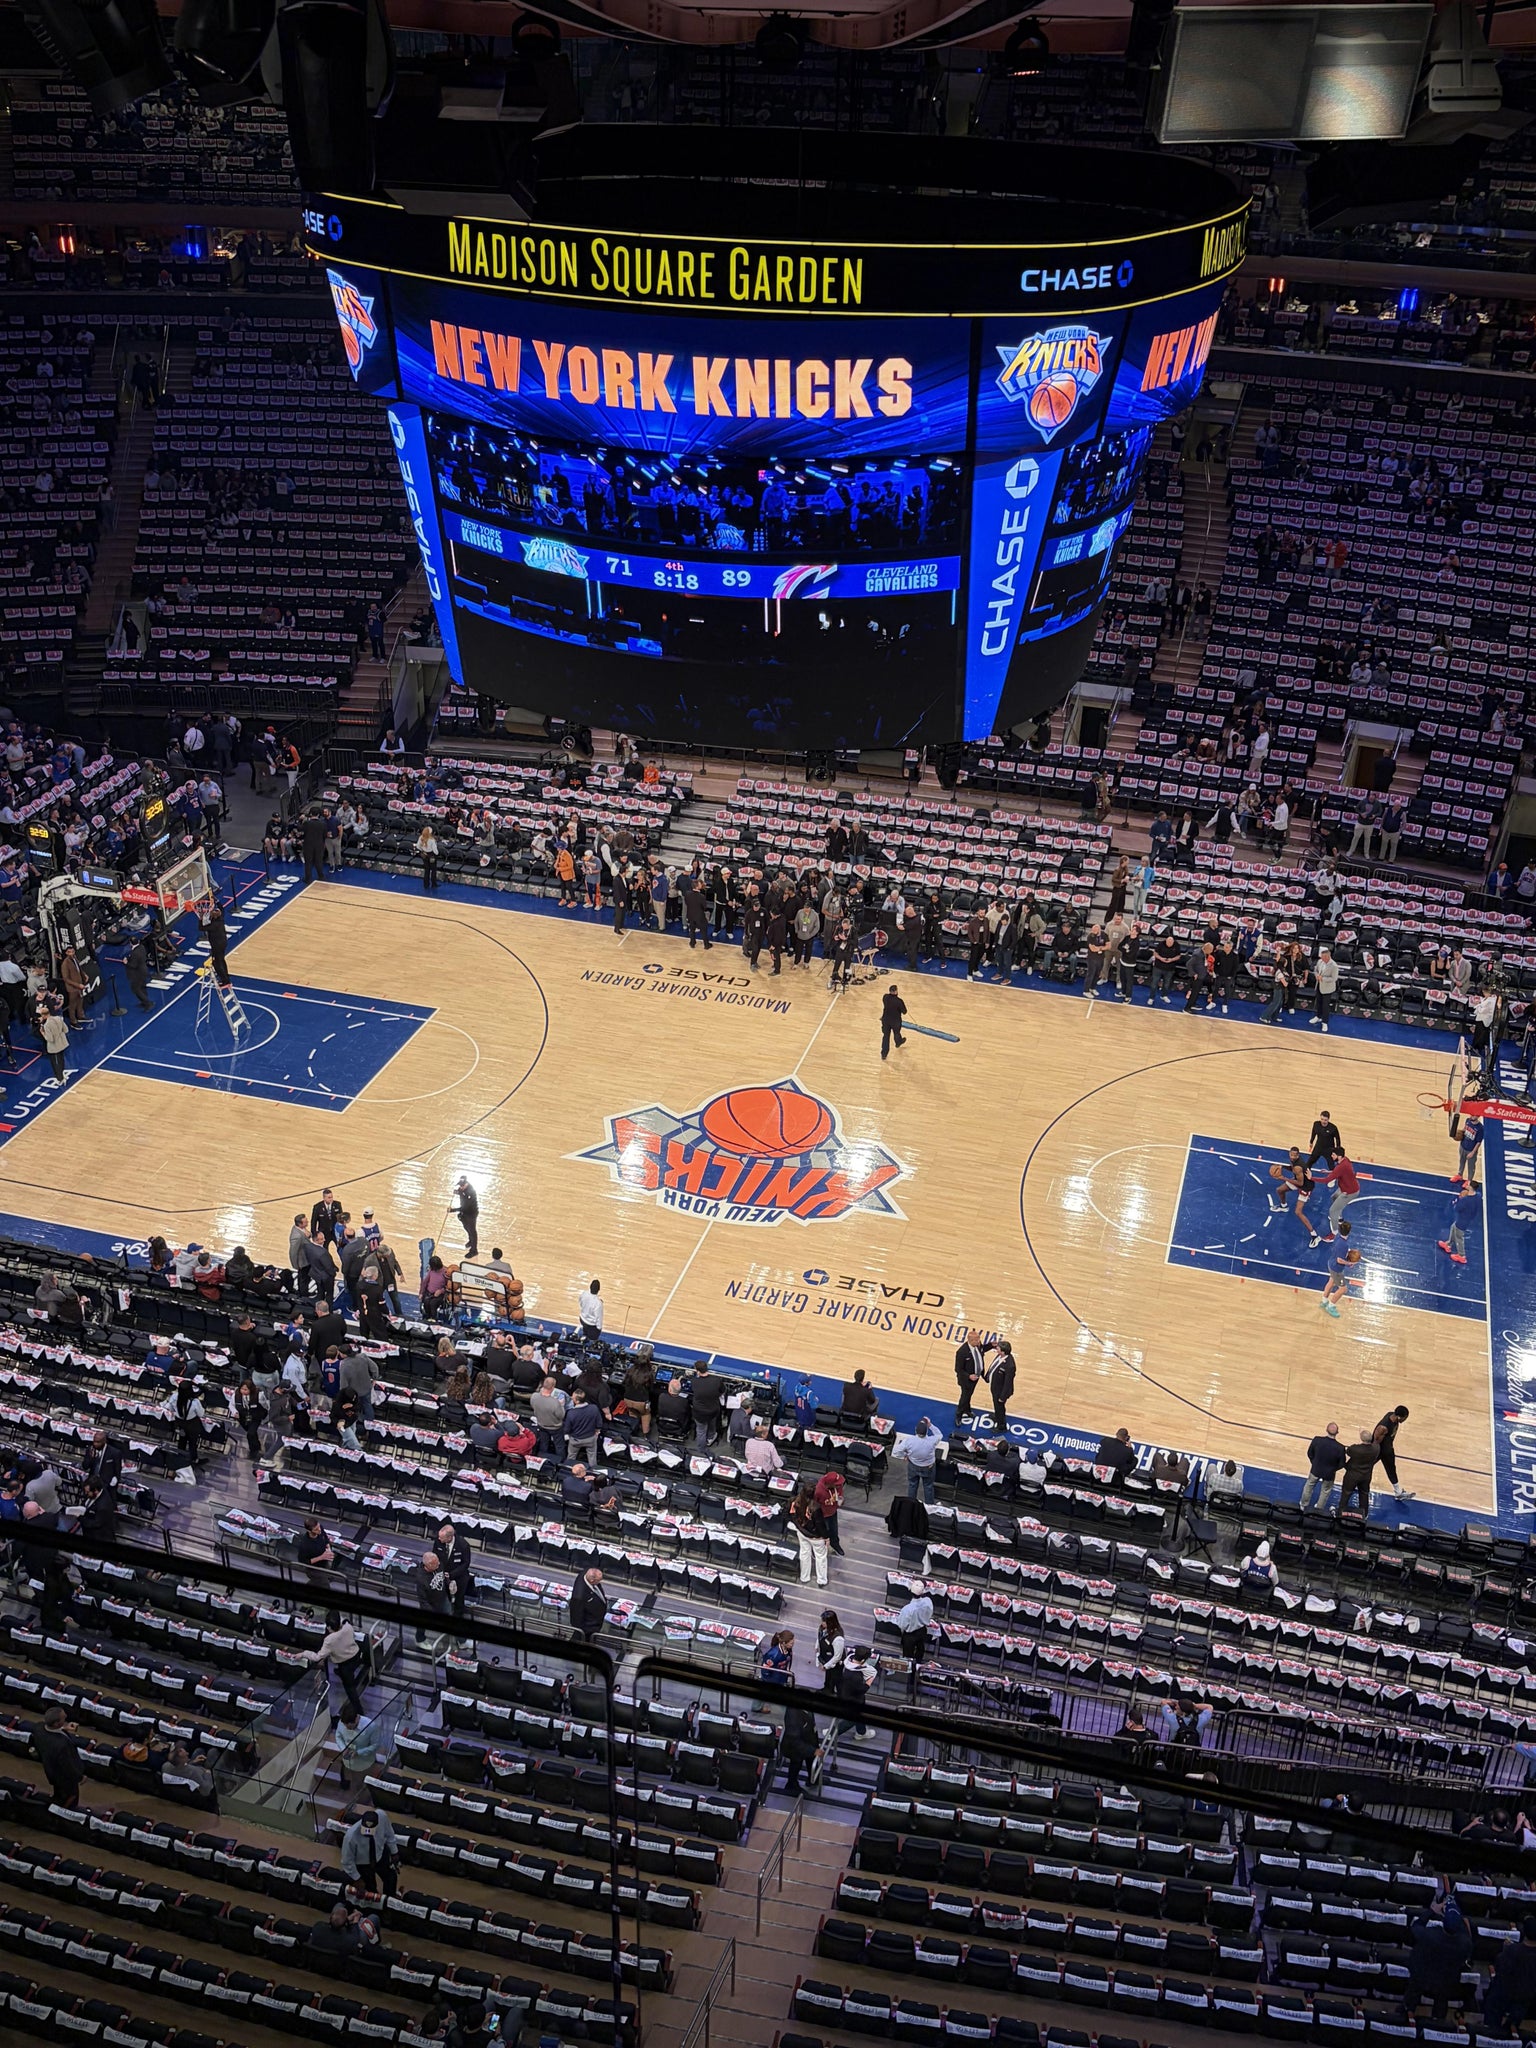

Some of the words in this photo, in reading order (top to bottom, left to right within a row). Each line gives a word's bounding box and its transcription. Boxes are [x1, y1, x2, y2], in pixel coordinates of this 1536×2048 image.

[448, 221, 578, 288] MADISON
[591, 237, 715, 299] SQUARE
[729, 246, 863, 304] GARDEN
[1020, 265, 1113, 292] CHASE
[1047, 330, 1066, 340] NEW
[1068, 329, 1086, 338] YORK
[430, 319, 521, 393] NEW
[532, 339, 678, 414] YORK
[692, 356, 913, 419] KNICKS
[1001, 334, 1100, 383] KNICKS
[1141, 325, 1196, 392] NEW
[399, 460, 441, 600] CHASE
[461, 519, 478, 534] NEW
[479, 523, 501, 538] YORK
[461, 527, 503, 553] KNICKS
[530, 541, 582, 569] KNICKS
[606, 557, 632, 576] 71
[665, 560, 684, 571] 4th
[1053, 543, 1082, 564] KNICKS
[654, 571, 699, 590] 8:18
[722, 570, 751, 587] 89
[865, 574, 938, 592] CAVALIERS
[866, 564, 938, 579] CLEVELAND
[981, 505, 1030, 656] CHASE
[146, 961, 194, 990] NEW
[231, 874, 300, 919] KNICKS
[580, 969, 645, 991] GARDEN
[647, 978, 712, 1002] SQUARE
[671, 967, 750, 988] CHASE
[715, 991, 792, 1014] MADISON
[1500, 1060, 1528, 1092] NEW
[4, 1069, 79, 1119] ULTRA
[614, 1117, 900, 1218] KNICKS
[1504, 1150, 1536, 1222] KNICKS
[663, 1191, 721, 1218] YORK
[724, 1206, 785, 1223] NEW
[724, 1280, 808, 1313] GARDEN
[835, 1275, 945, 1308] CHASE
[813, 1297, 897, 1332] SQUARE
[961, 1413, 1049, 1445] Gogle
[1052, 1433, 1065, 1448] by
[1509, 1431, 1536, 1514] ULTRA
